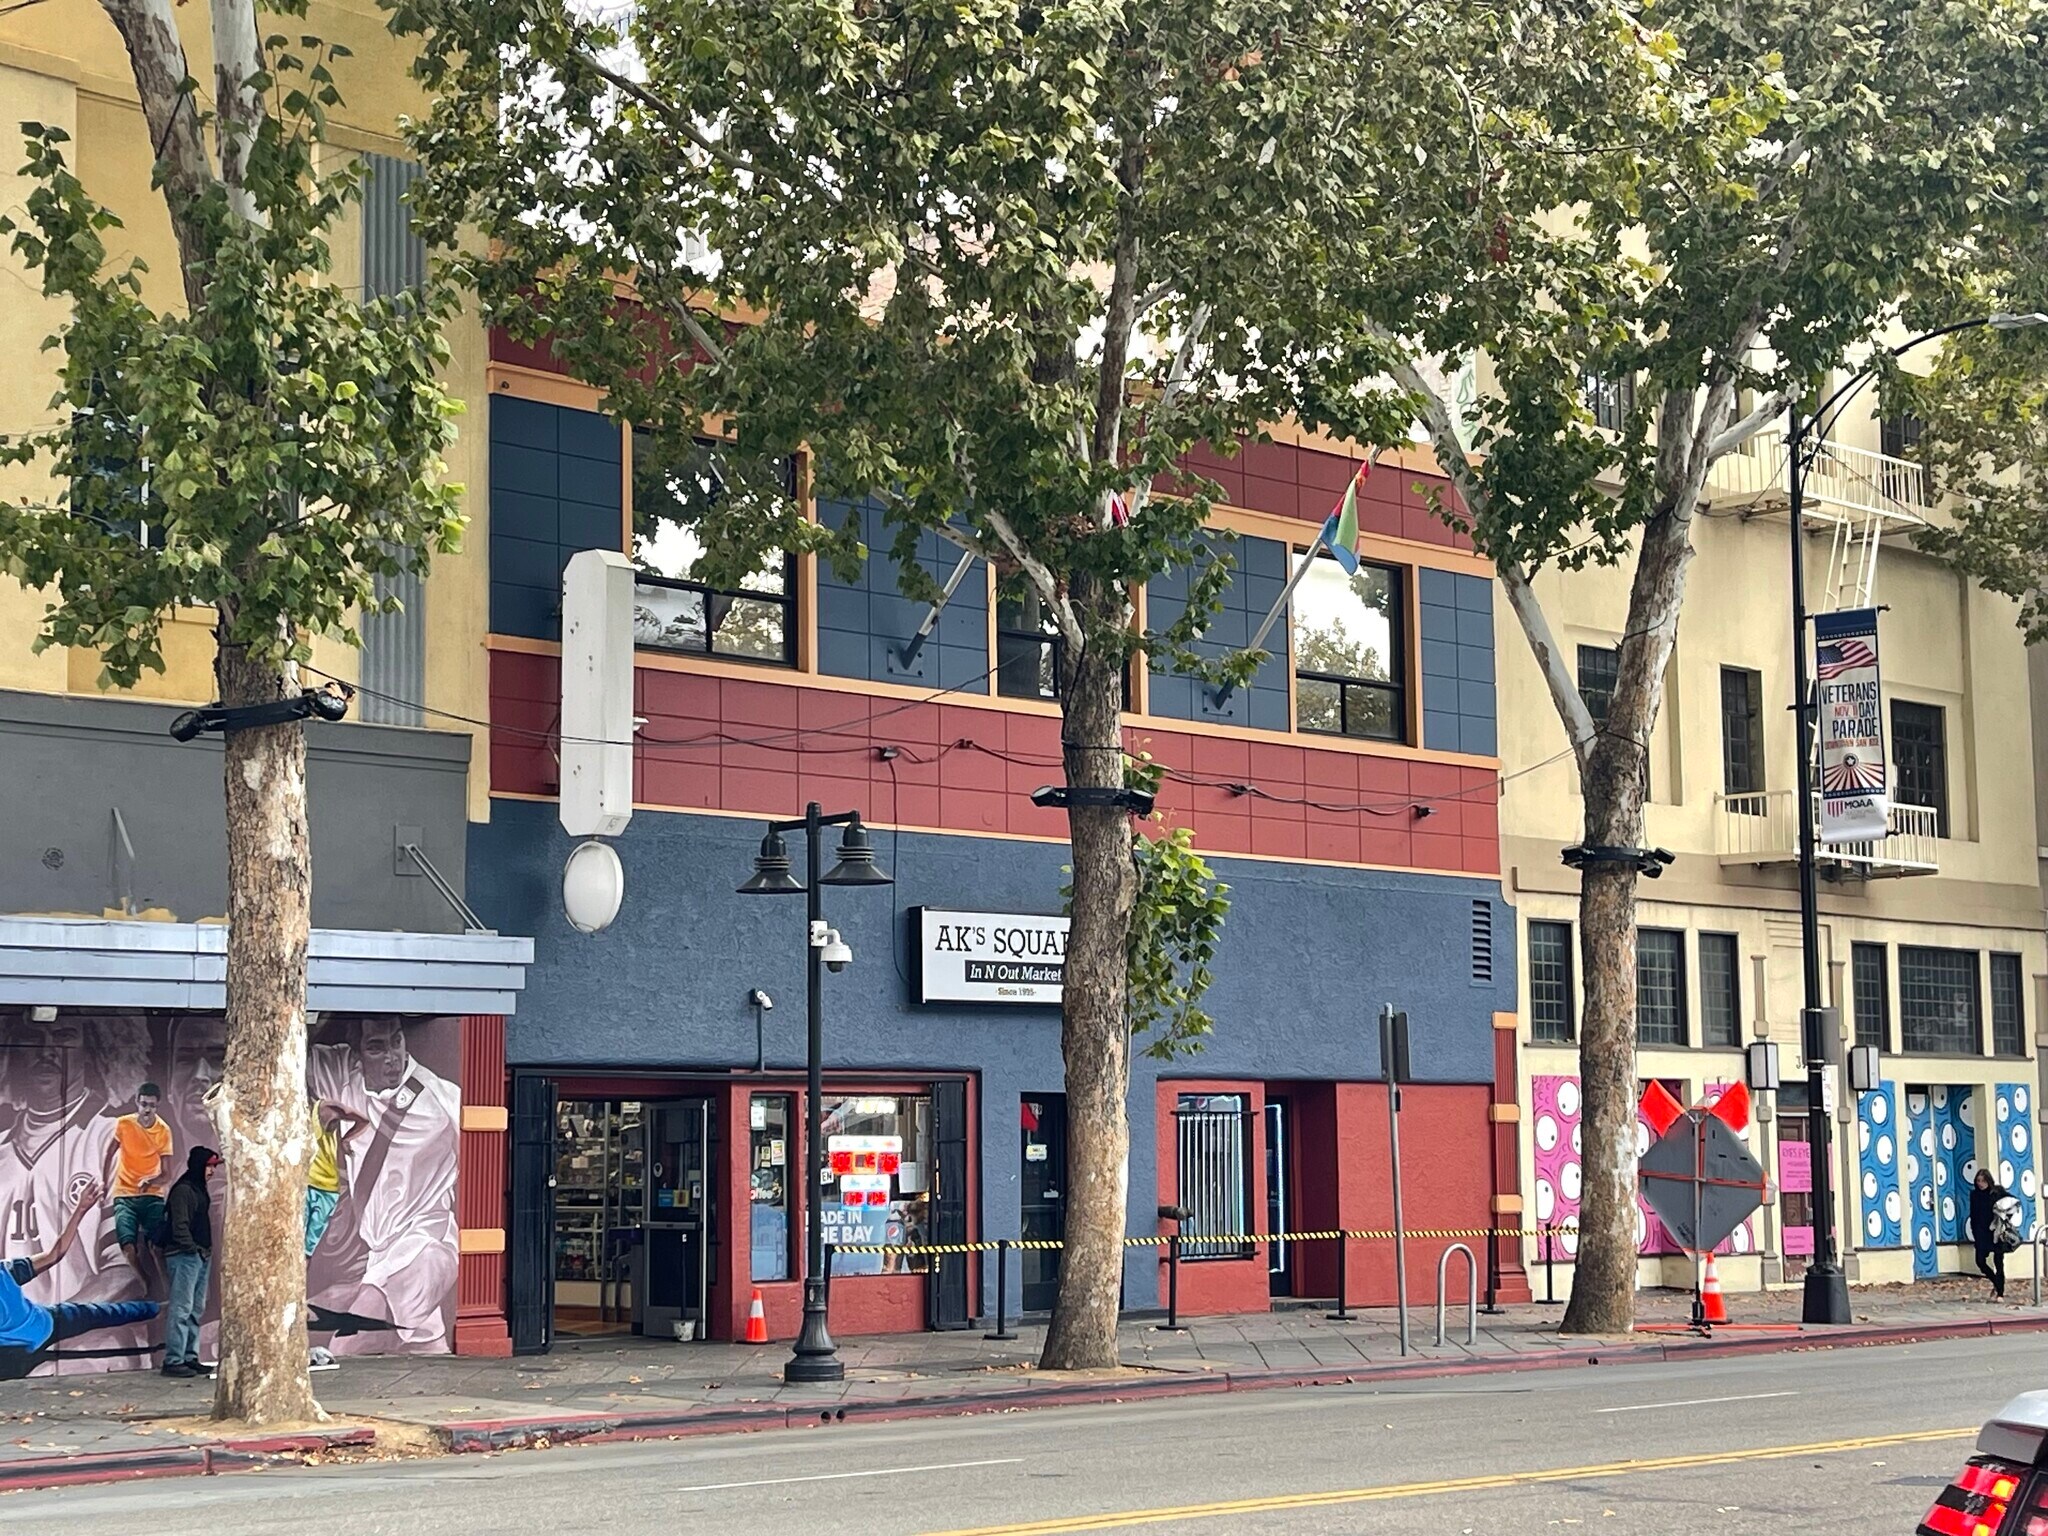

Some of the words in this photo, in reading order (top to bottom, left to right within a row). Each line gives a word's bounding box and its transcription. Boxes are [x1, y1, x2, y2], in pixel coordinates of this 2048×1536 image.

[1820, 681, 1876, 704] VETERANS
[1858, 701, 1876, 718] DAY
[1832, 717, 1878, 739] PARADE
[1844, 799, 1873, 809] MOAA
[935, 925, 985, 951] AK'S
[970, 964, 982, 978] In
[984, 965, 996, 979] N
[998, 965, 1019, 979] Out
[1021, 966, 1061, 981] Market
[821, 1171, 832, 1182] EN
[11, 1200, 39, 1240] 10
[848, 1211, 862, 1225] IN
[842, 1225, 873, 1244] BAY
